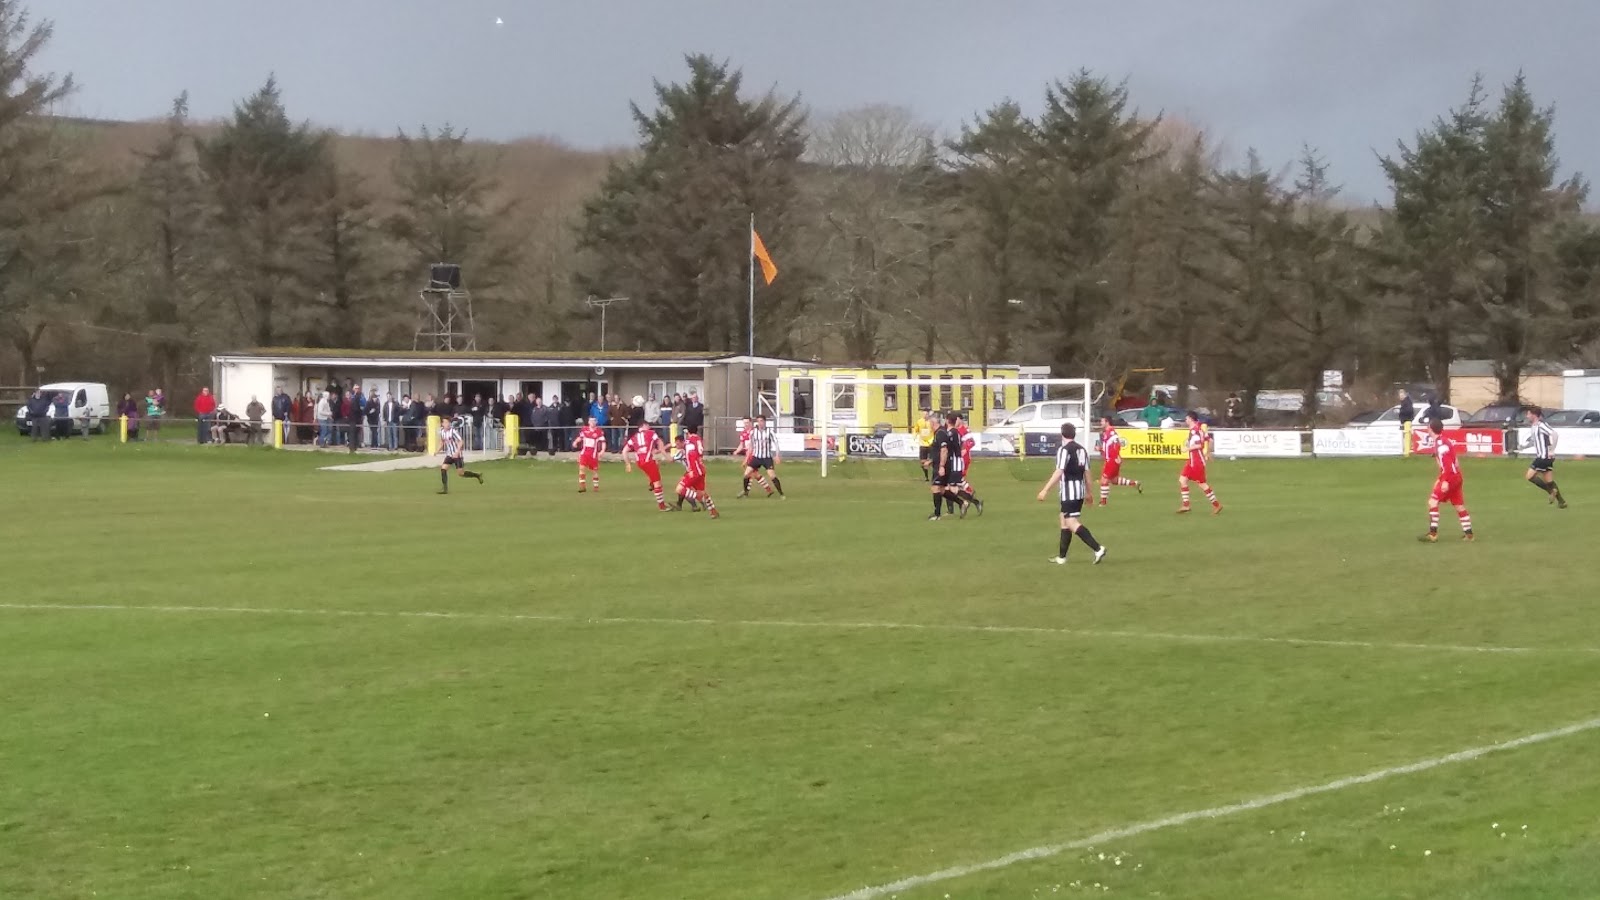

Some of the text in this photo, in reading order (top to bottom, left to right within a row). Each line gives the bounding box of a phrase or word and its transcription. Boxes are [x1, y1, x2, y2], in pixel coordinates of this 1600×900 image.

[1147, 433, 1164, 443] THE
[1237, 434, 1278, 443] JOLLY'S
[850, 443, 882, 453] OVEN
[1316, 438, 1356, 449] Alfords
[1130, 444, 1182, 455] FISHERMEN
